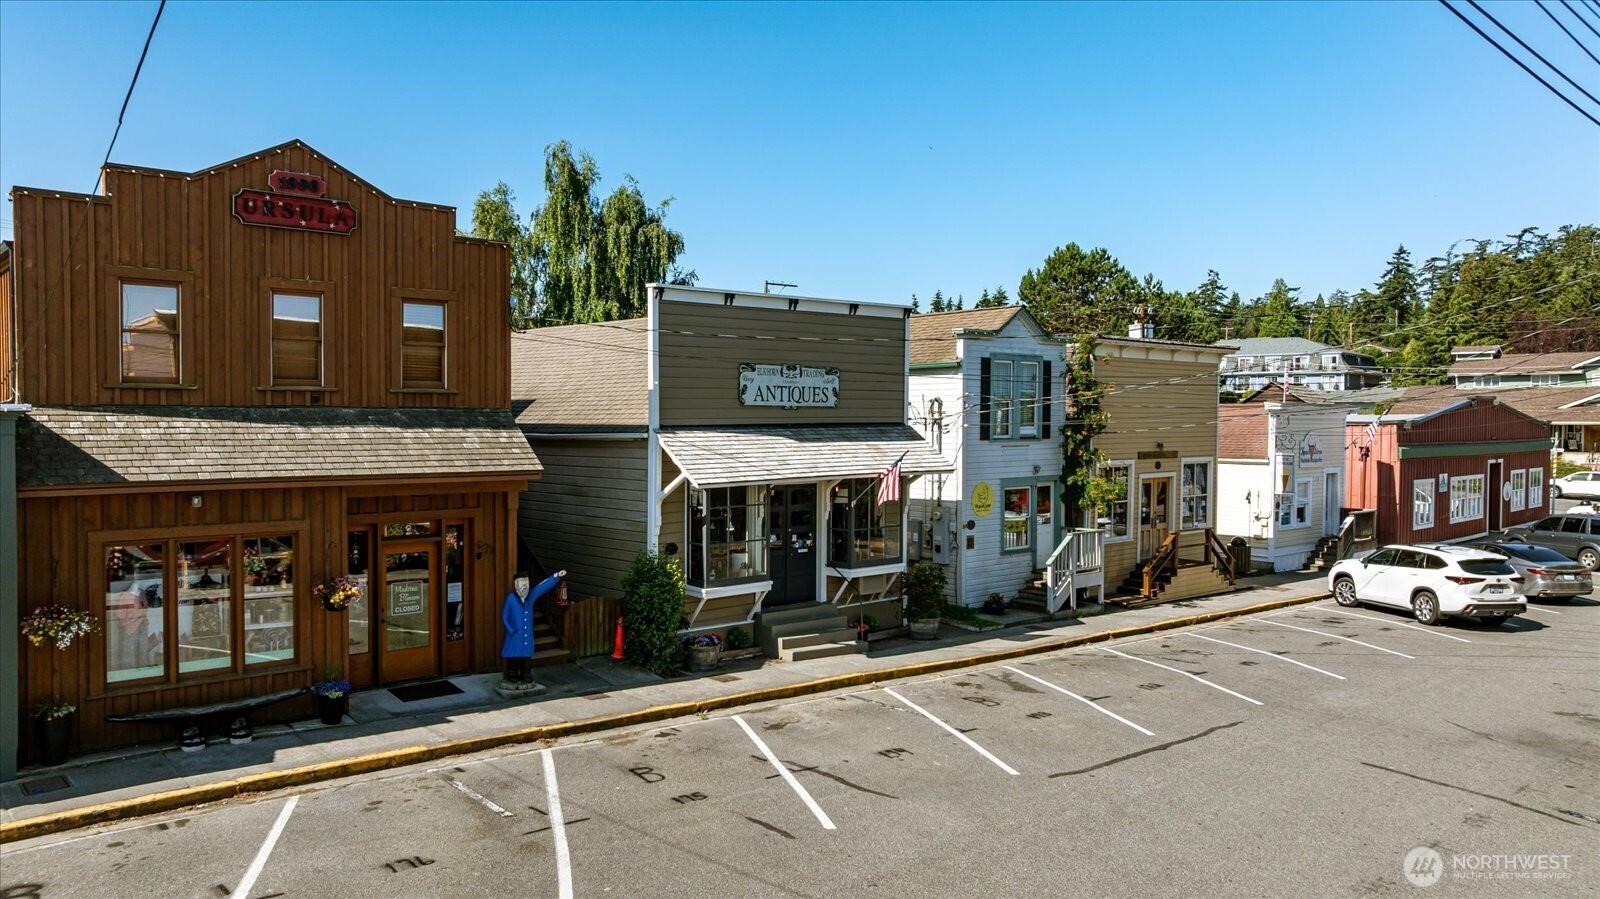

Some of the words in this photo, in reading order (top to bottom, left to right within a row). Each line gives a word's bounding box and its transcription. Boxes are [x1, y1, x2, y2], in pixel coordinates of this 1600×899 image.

[242, 198, 349, 226] URSULA
[757, 367, 780, 377] ELKHORN
[803, 369, 825, 378] TRADING
[753, 385, 829, 404] ANTIQUES
[394, 604, 420, 613] CLOSED
[628, 766, 666, 783] B
[670, 791, 709, 805] 175
